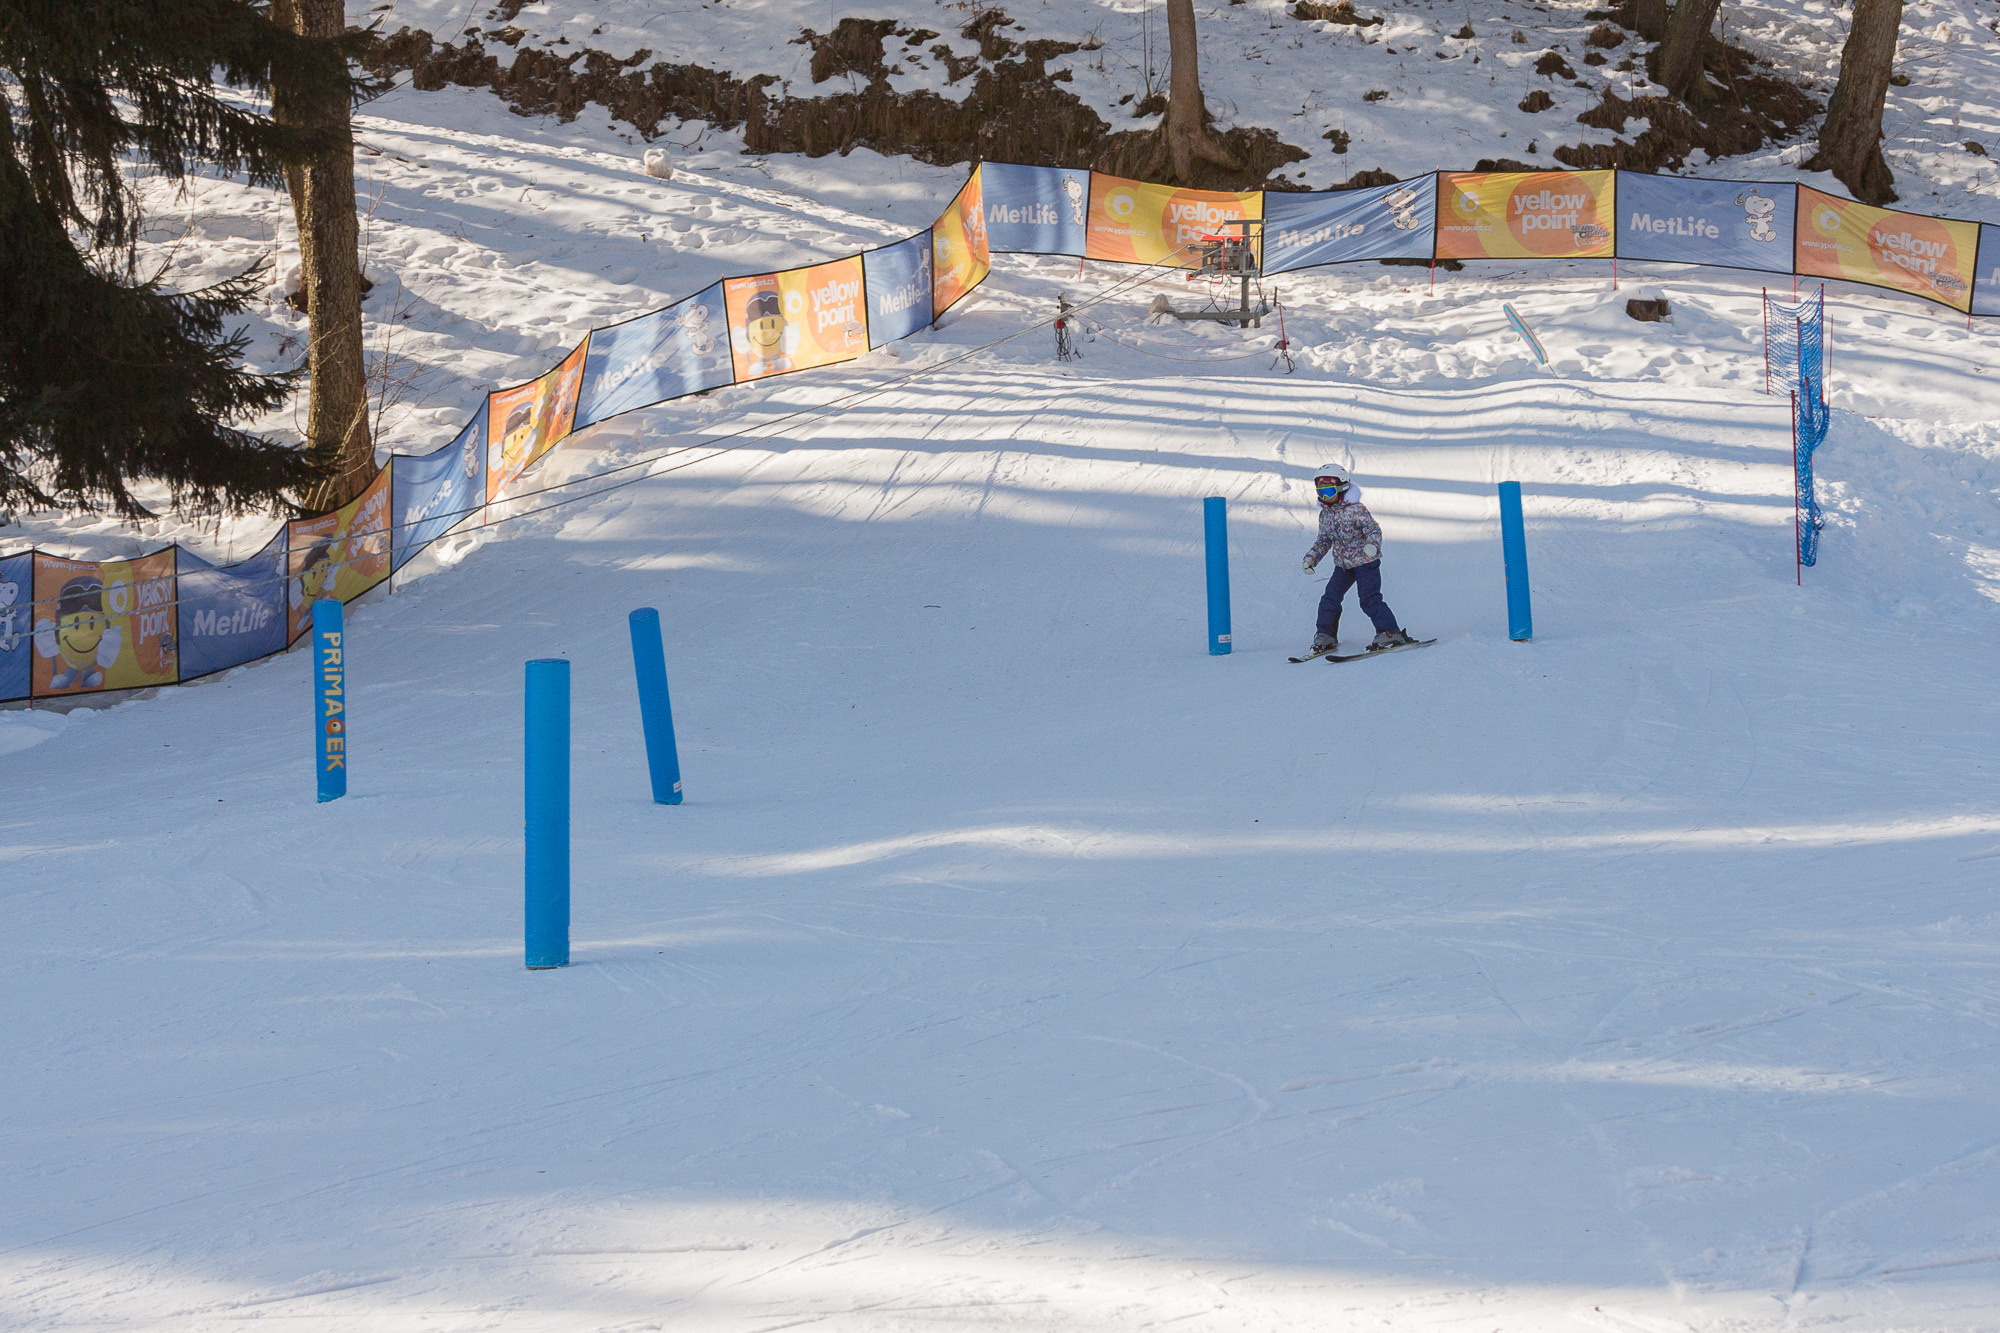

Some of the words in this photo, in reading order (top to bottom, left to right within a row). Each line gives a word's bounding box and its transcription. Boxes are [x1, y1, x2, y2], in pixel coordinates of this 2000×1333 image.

[989, 202, 1059, 225] MetLife
[1514, 189, 1586, 214] yellow
[1522, 209, 1579, 234] point
[1630, 212, 1720, 239] MetLife
[1874, 230, 1949, 258] yellow
[1882, 245, 1938, 275] point
[810, 279, 860, 313] yellow
[879, 283, 921, 317] MetLife
[817, 299, 856, 334] point
[192, 602, 270, 637] MetLife
